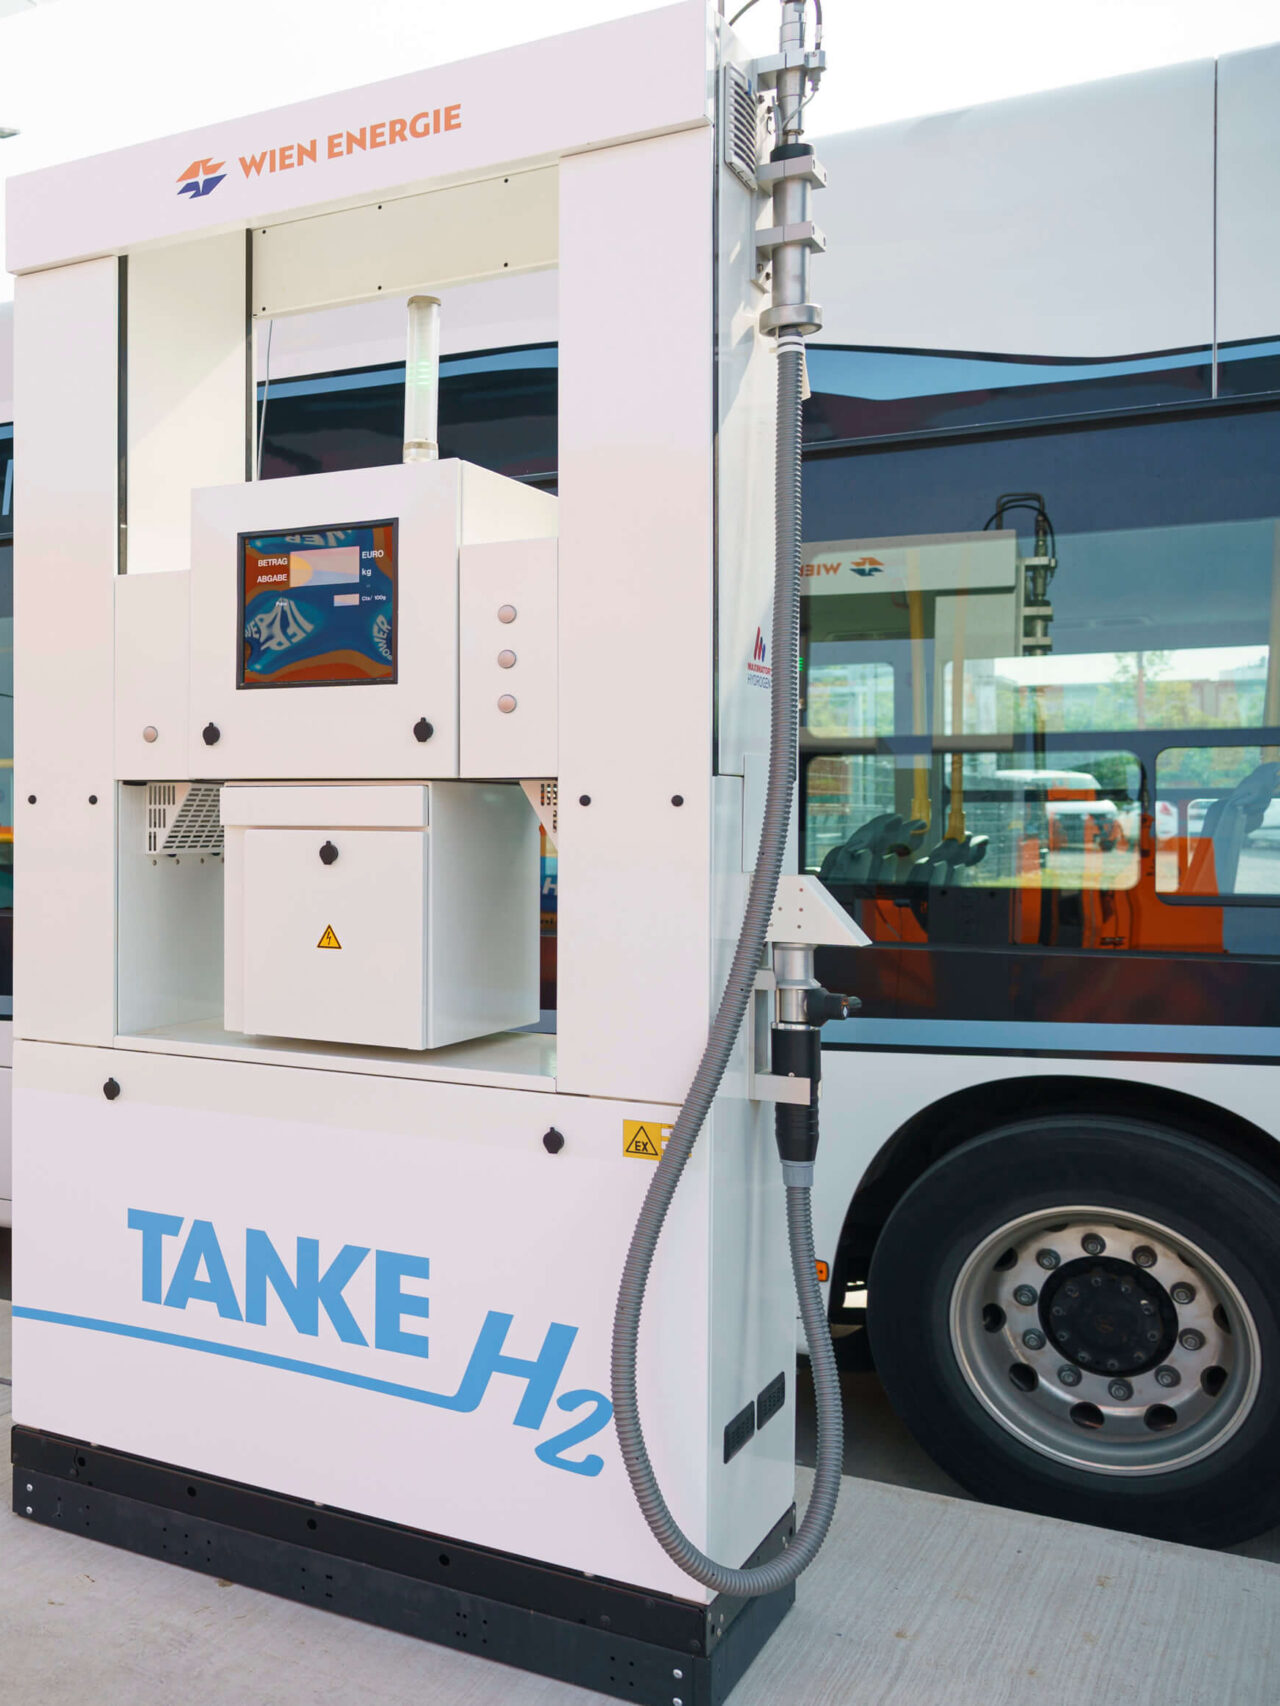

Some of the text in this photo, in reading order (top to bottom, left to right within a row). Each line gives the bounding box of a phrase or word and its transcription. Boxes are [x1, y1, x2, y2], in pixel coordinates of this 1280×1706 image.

[238, 102, 463, 180] WIEN ENERGIE
[258, 549, 384, 567] BETRAG EURO
[257, 567, 372, 583] ABGABE kg
[634, 1140, 649, 1153] EX
[127, 1207, 614, 1478] TANKE H2
